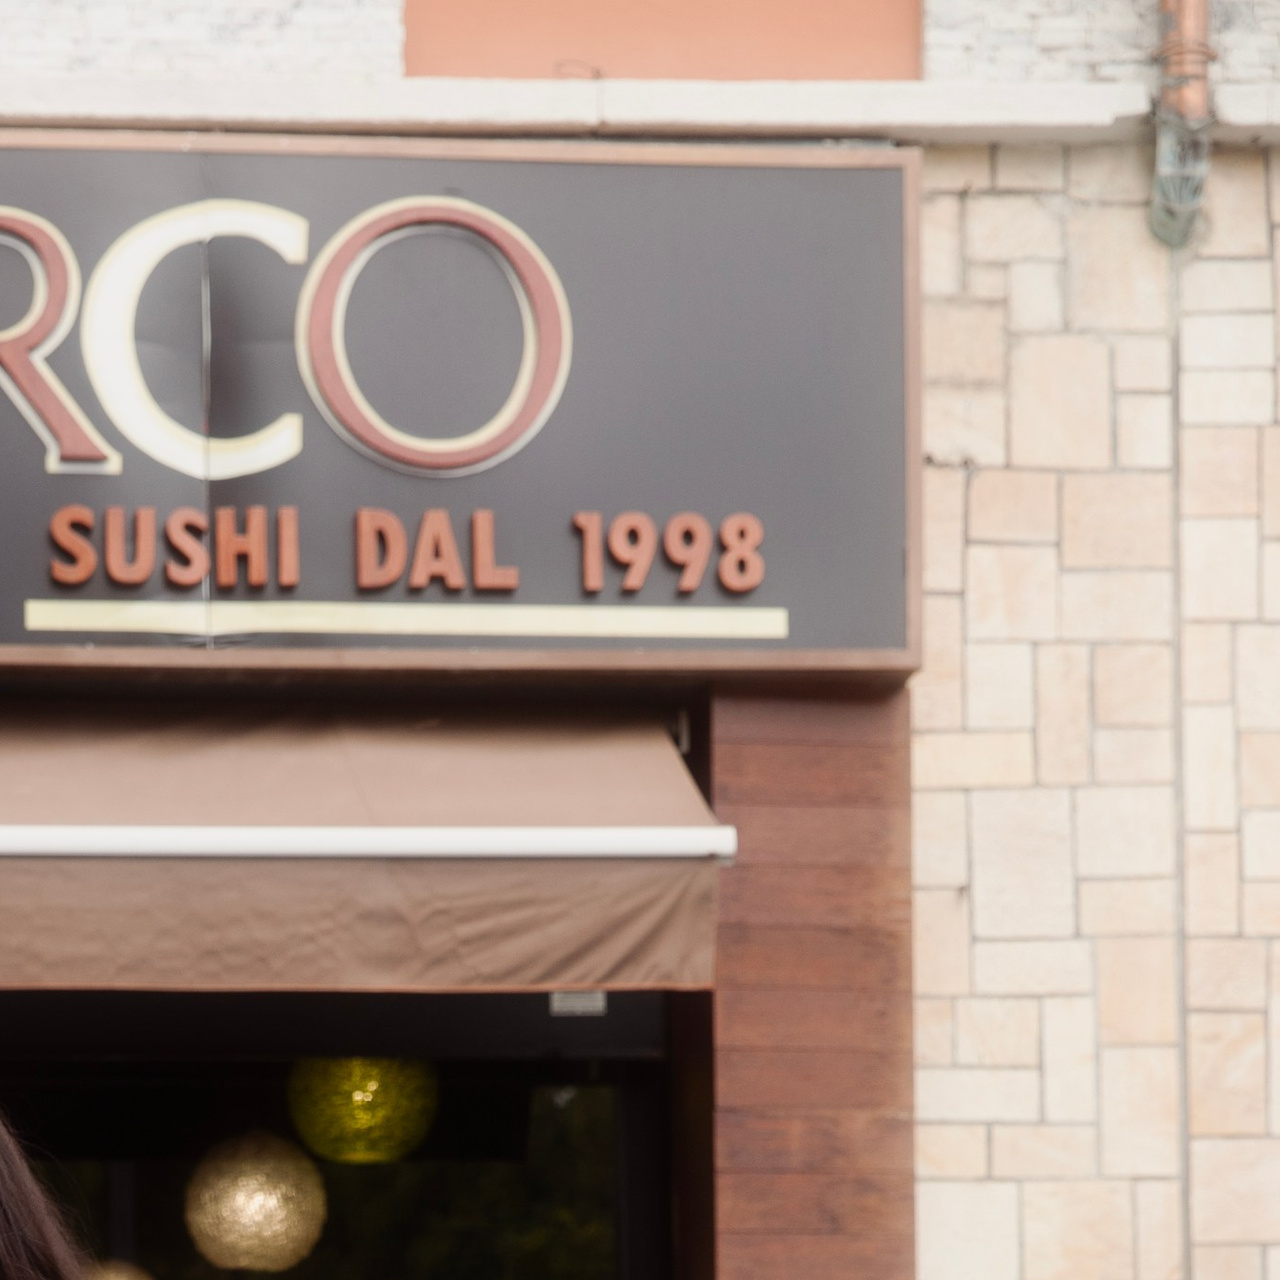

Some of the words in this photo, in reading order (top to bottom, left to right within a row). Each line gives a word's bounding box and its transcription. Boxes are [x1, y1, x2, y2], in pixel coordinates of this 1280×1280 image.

[49, 505, 300, 588] SUSHI
[355, 508, 519, 591] DAL
[571, 511, 766, 593] 1998
